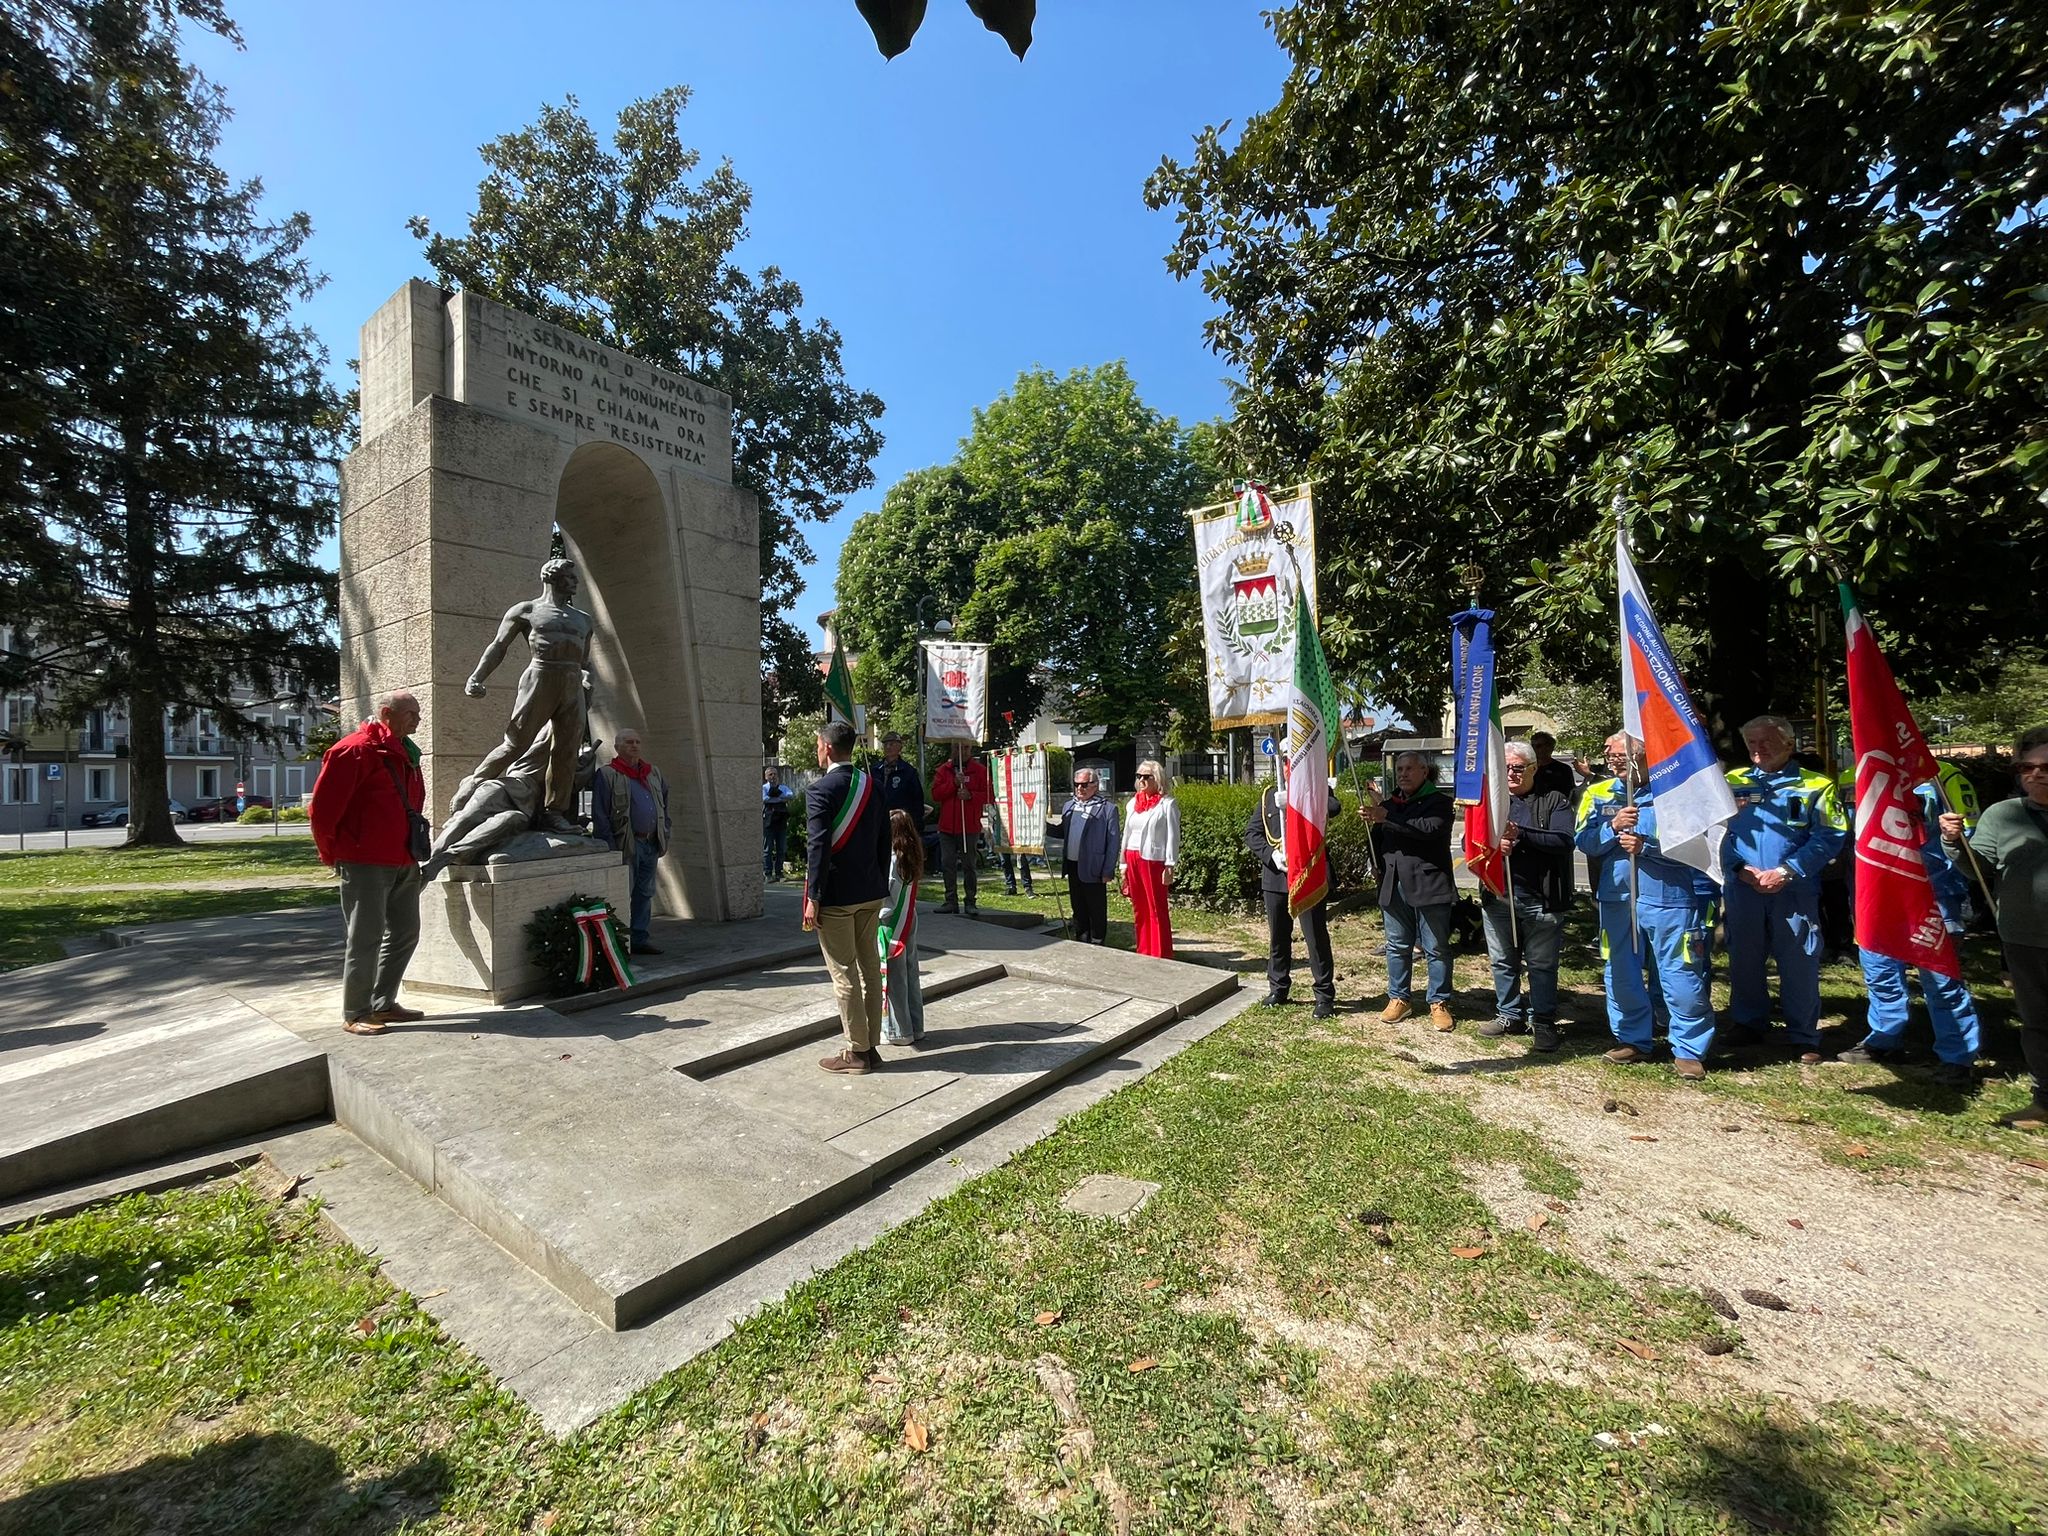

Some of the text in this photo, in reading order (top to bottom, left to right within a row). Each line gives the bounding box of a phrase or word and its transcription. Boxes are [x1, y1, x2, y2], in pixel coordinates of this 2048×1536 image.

[507, 341, 706, 426] INTORNO AL MONUMENTO
[532, 328, 609, 368] SERRATO
[624, 363, 633, 378] O
[507, 367, 705, 447] CHE SI CHIAMA ORA
[507, 391, 518, 408] E
[528, 398, 596, 432] SEMPRE
[1634, 613, 1674, 672] REGIONE AUTONOMA
[1636, 631, 1678, 694] PROTEZIONE
[1673, 692, 1699, 727] CIVILE
[1464, 664, 1485, 772] SEZIONE DI MONFALCONE
[50, 764, 59, 775] P
